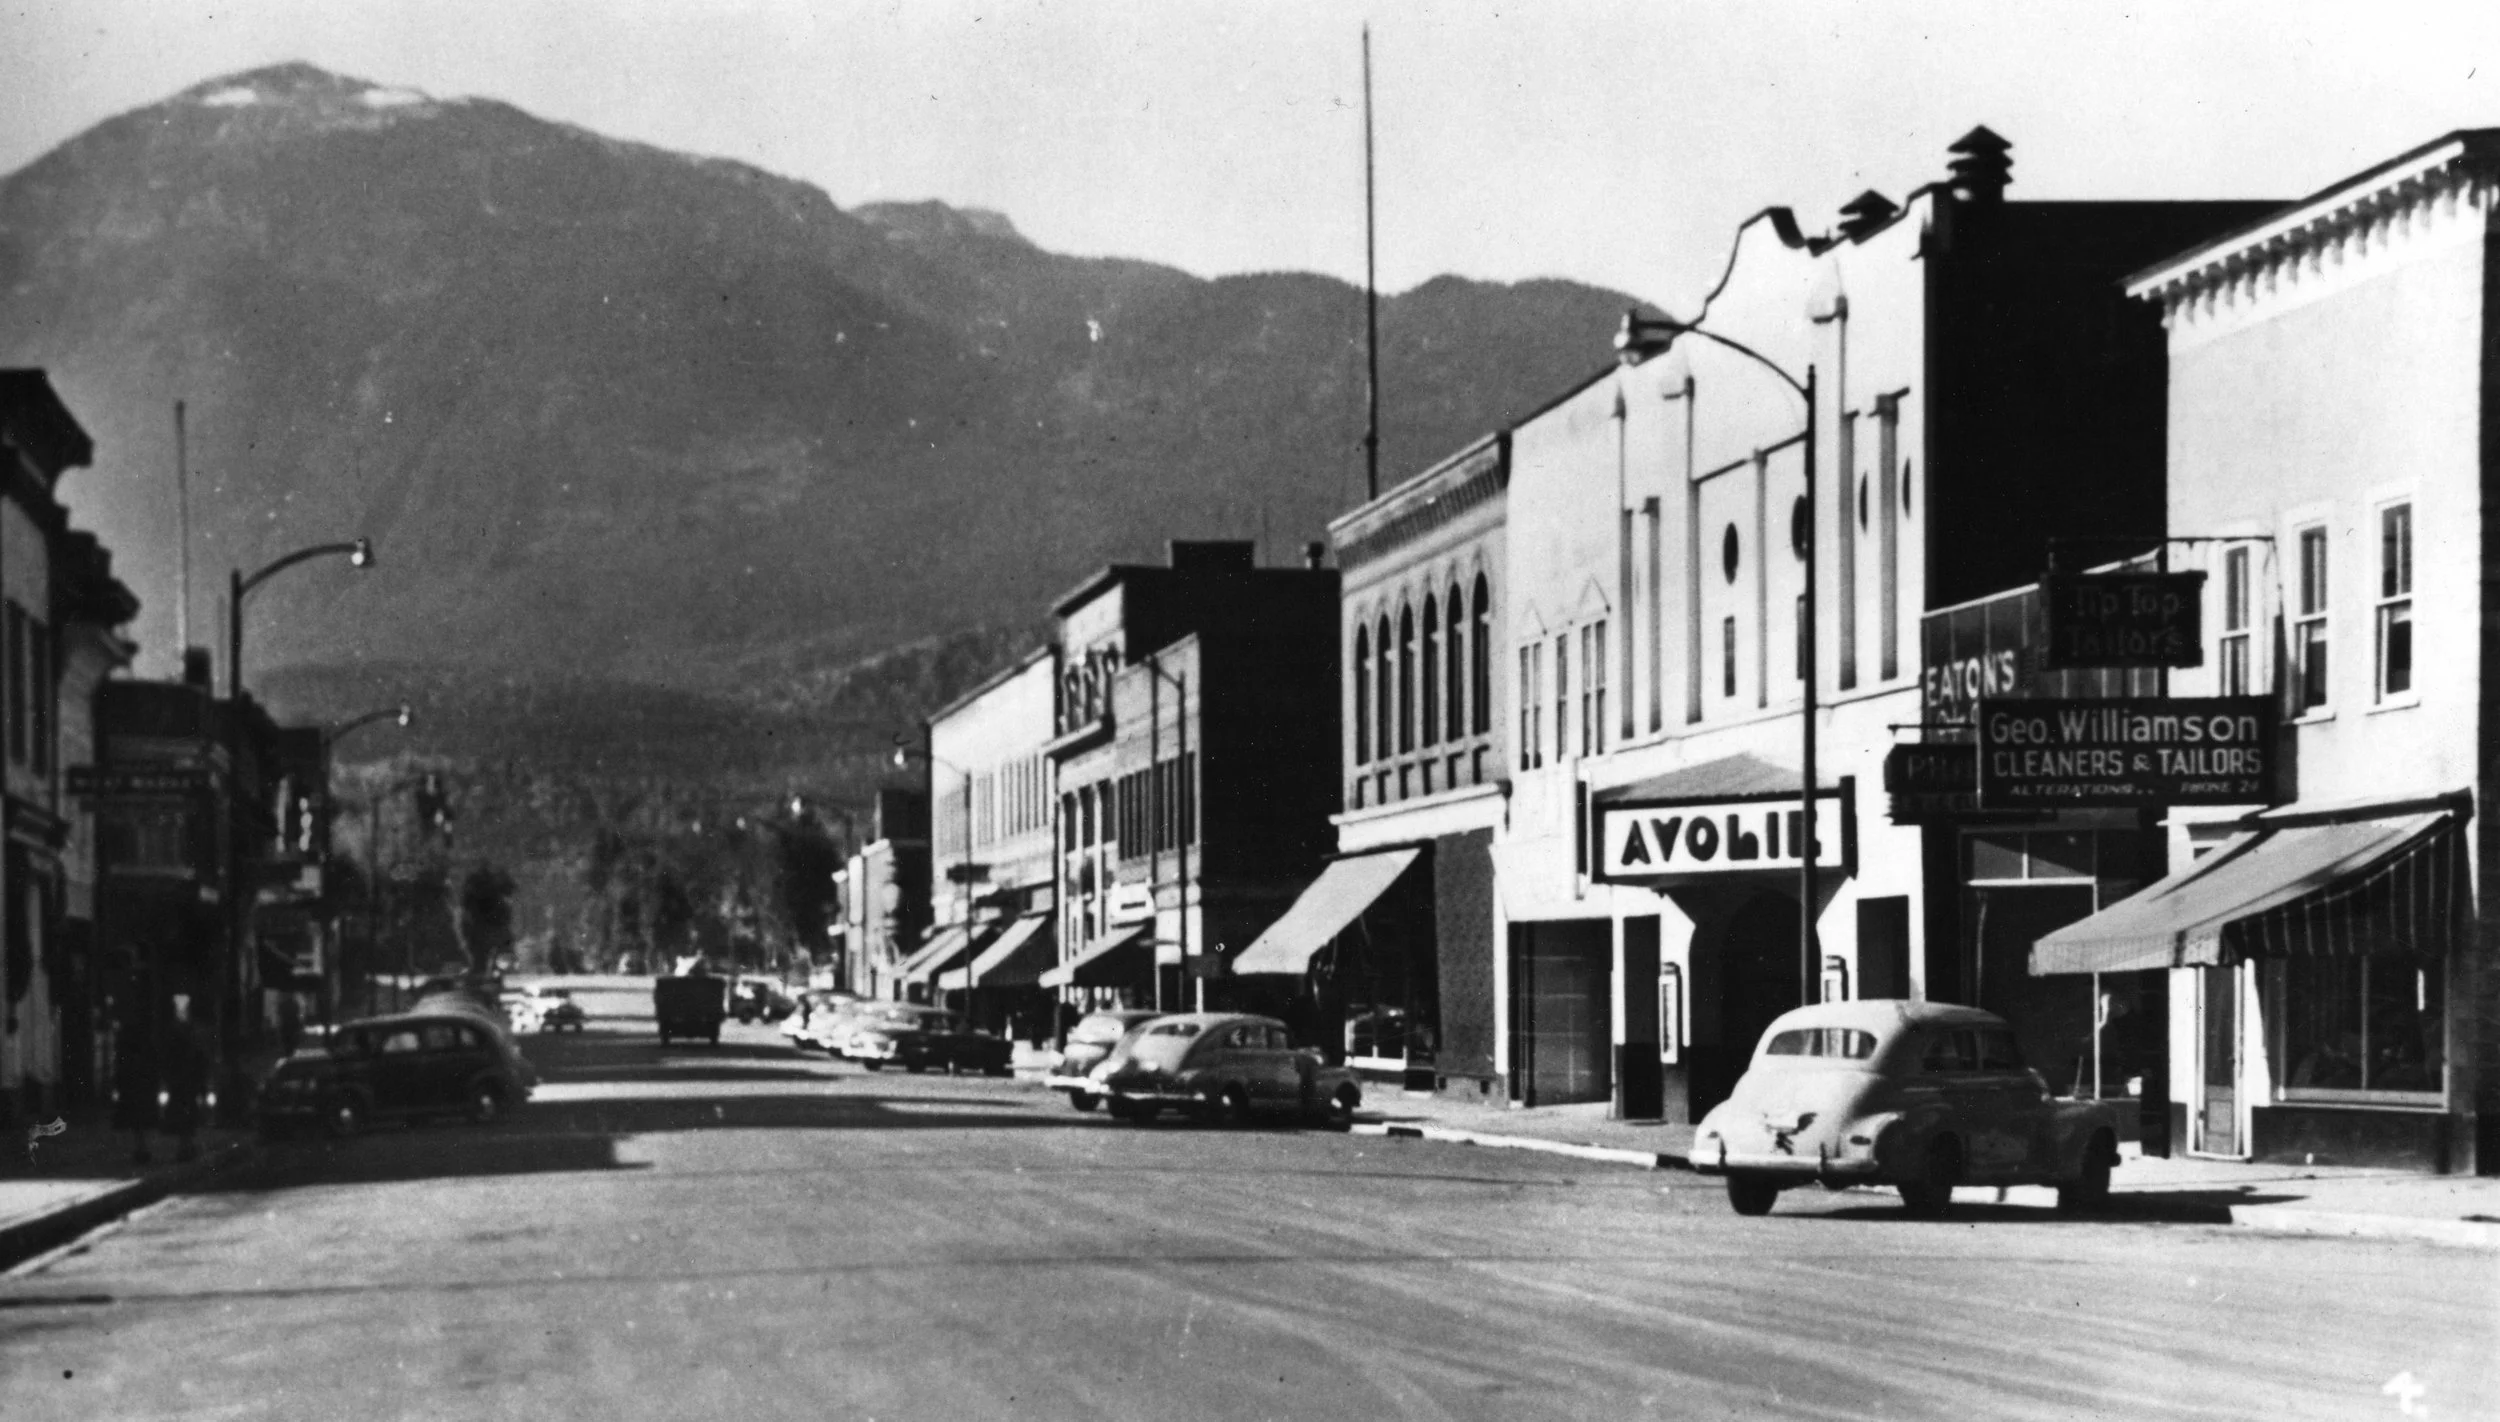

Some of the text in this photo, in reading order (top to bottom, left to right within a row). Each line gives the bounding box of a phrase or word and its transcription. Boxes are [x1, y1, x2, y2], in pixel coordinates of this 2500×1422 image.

[2073, 583, 2183, 623] Tip Top
[1926, 650, 2015, 707] EATON'S
[1990, 711, 2055, 744] Geo.
[2058, 707, 2258, 743] Williamson
[1993, 749, 2124, 777] CLEANERS
[2132, 753, 2151, 771] &
[2157, 747, 2261, 775] TAILORS
